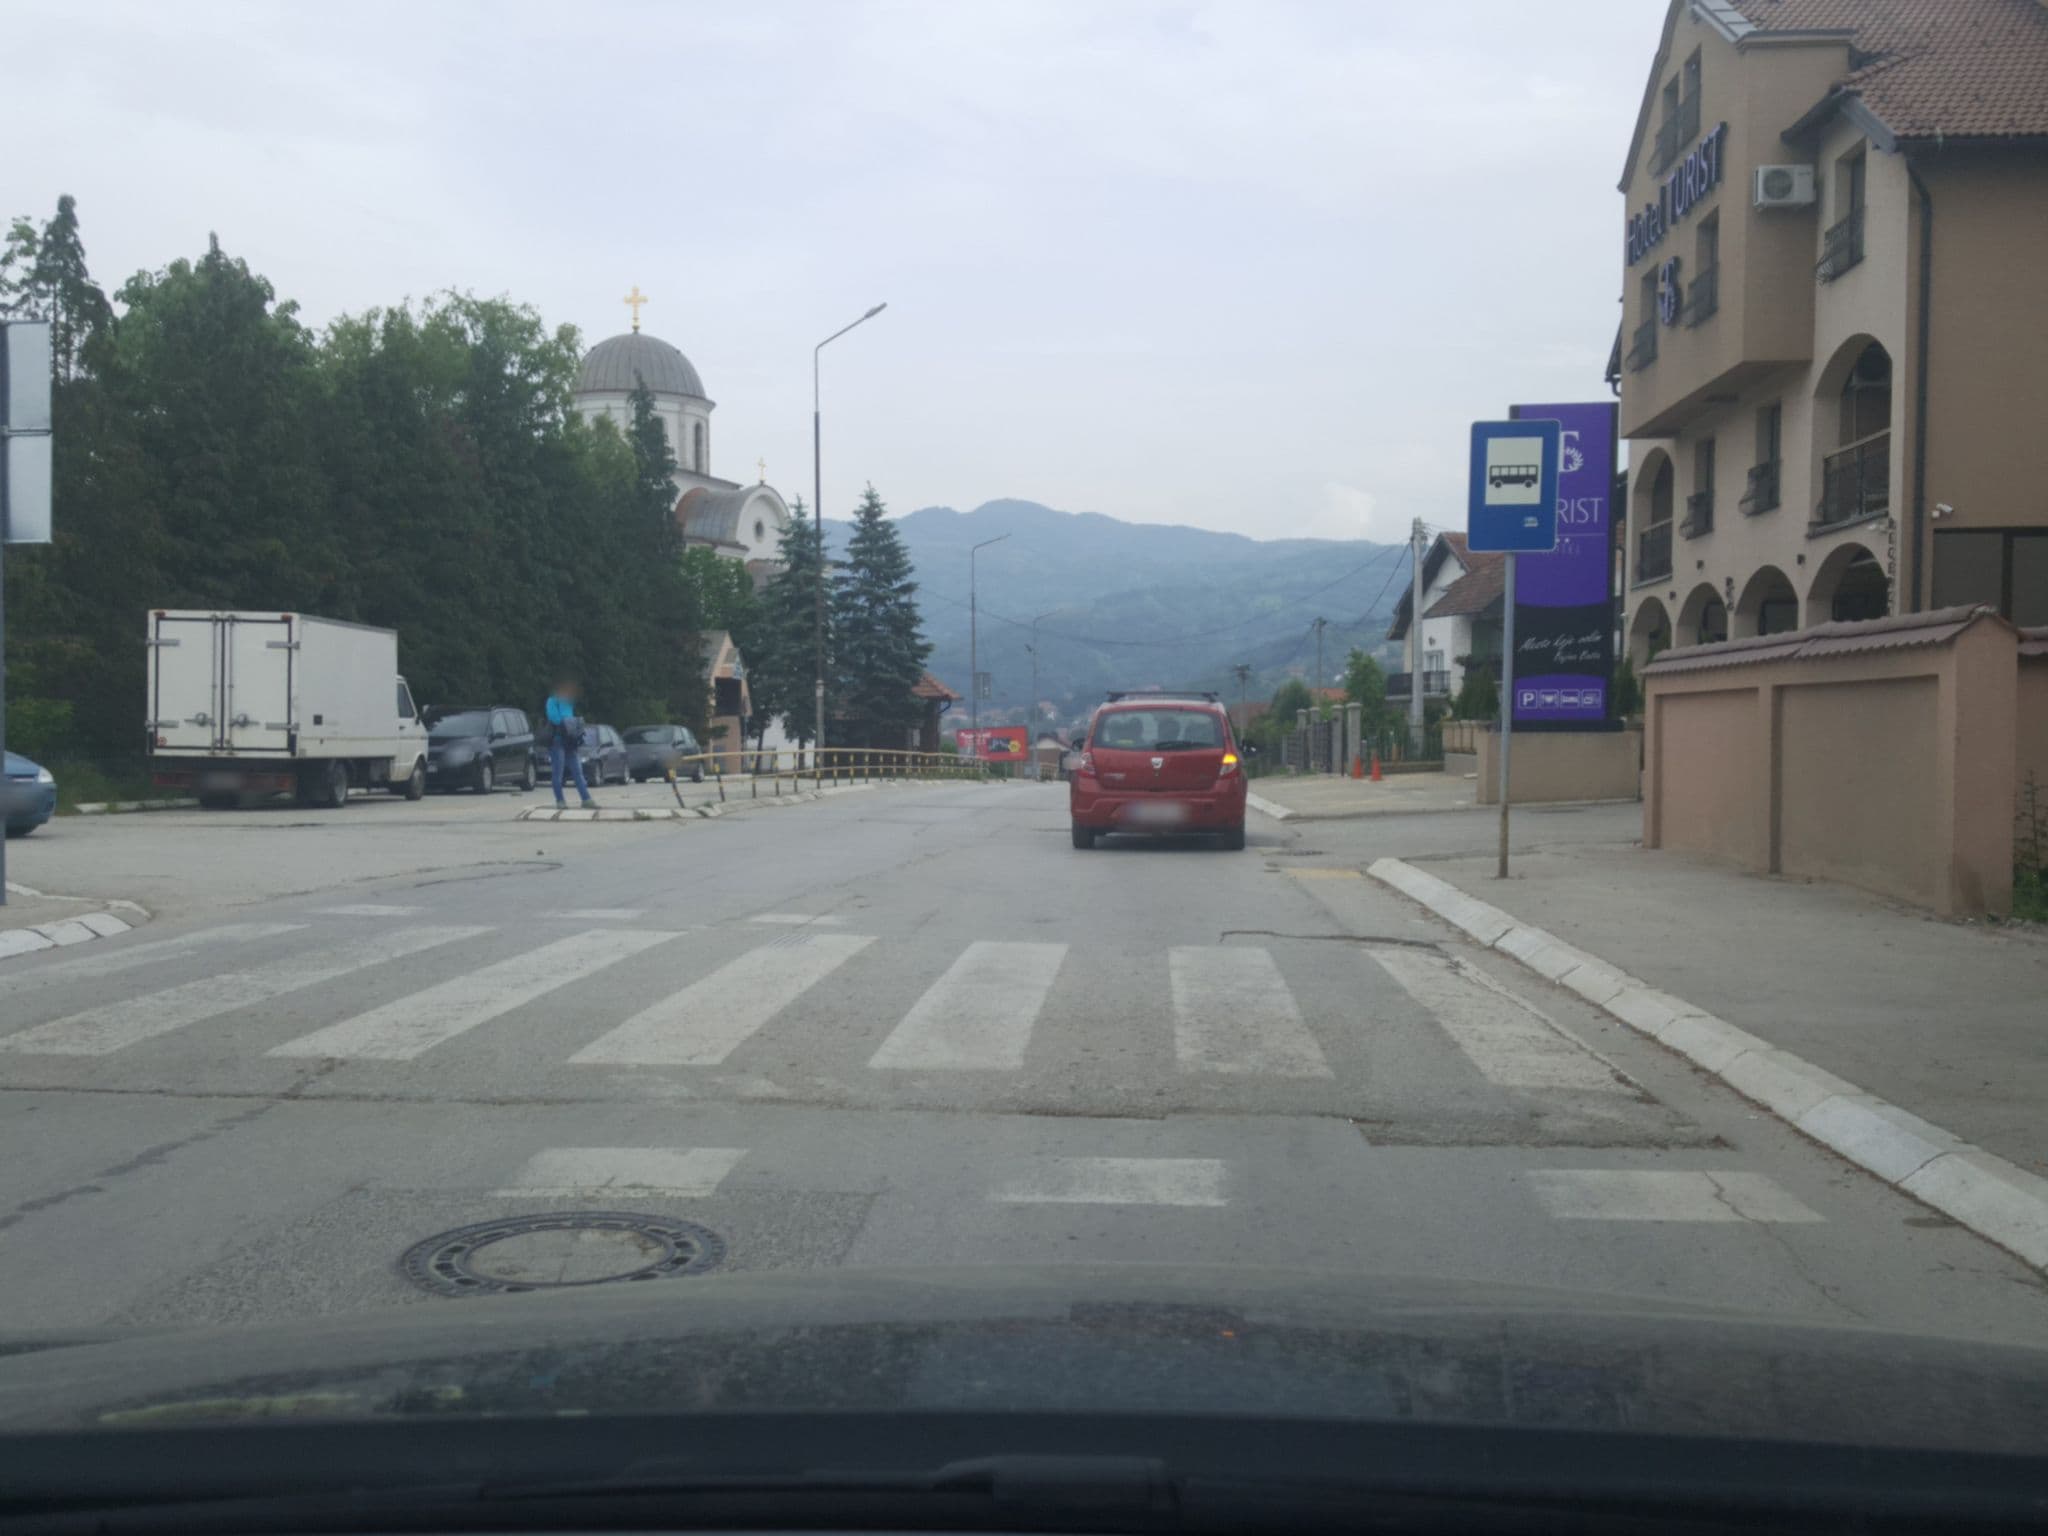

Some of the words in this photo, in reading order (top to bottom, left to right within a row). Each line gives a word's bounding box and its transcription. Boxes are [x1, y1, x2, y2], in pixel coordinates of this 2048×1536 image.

[1628, 186, 1667, 266] Hotel
[1667, 122, 1728, 225] TURIST
[1558, 498, 1604, 523] RIST
[1523, 692, 1535, 706] P
